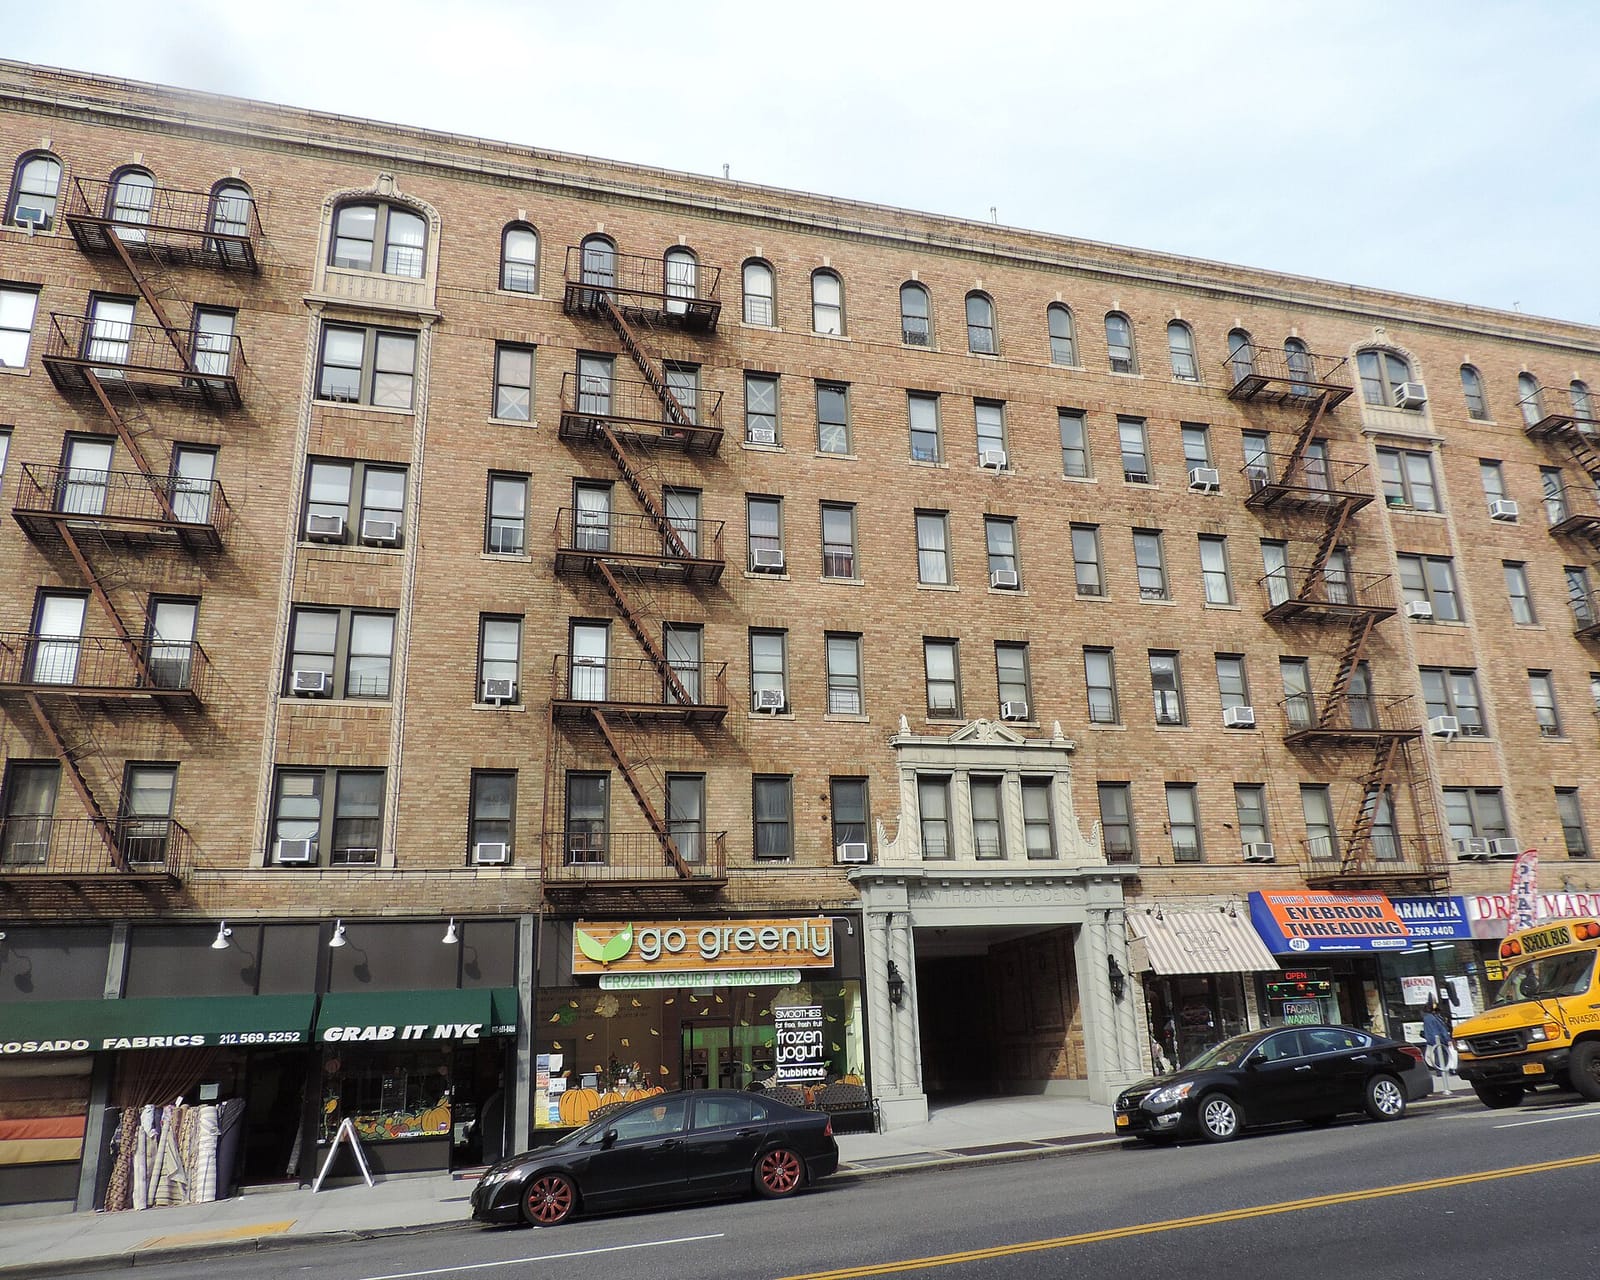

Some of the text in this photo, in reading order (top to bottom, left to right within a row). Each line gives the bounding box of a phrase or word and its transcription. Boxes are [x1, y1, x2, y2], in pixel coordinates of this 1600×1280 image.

[908, 887, 1081, 903] HAWTHORNE GARDENS
[1517, 865, 1532, 927] PHAR
[1285, 905, 1383, 919] EYEBROW
[1394, 901, 1460, 918] ARMACIA
[1475, 895, 1510, 918] DR
[1285, 920, 1401, 935] THREADING
[1407, 925, 1454, 936] 2.569.4400
[637, 920, 830, 961] go greenly
[1521, 926, 1569, 953] SCHOOL BUS
[604, 969, 795, 988] FROZEN YOGURT & SMOOTHIES
[775, 1008, 821, 1018] SMOOTHIES
[1286, 1004, 1315, 1013] FACIAL
[1286, 1014, 1318, 1024] WAXING
[323, 1025, 395, 1041] GRAB
[400, 1024, 429, 1039] IT
[432, 1023, 483, 1039] NYC
[776, 1029, 822, 1044] frozen
[0, 1031, 300, 1053] OSADO FABRICS 212.569.5252
[776, 1042, 823, 1062] yogurt
[777, 1067, 823, 1078] bubbletea
